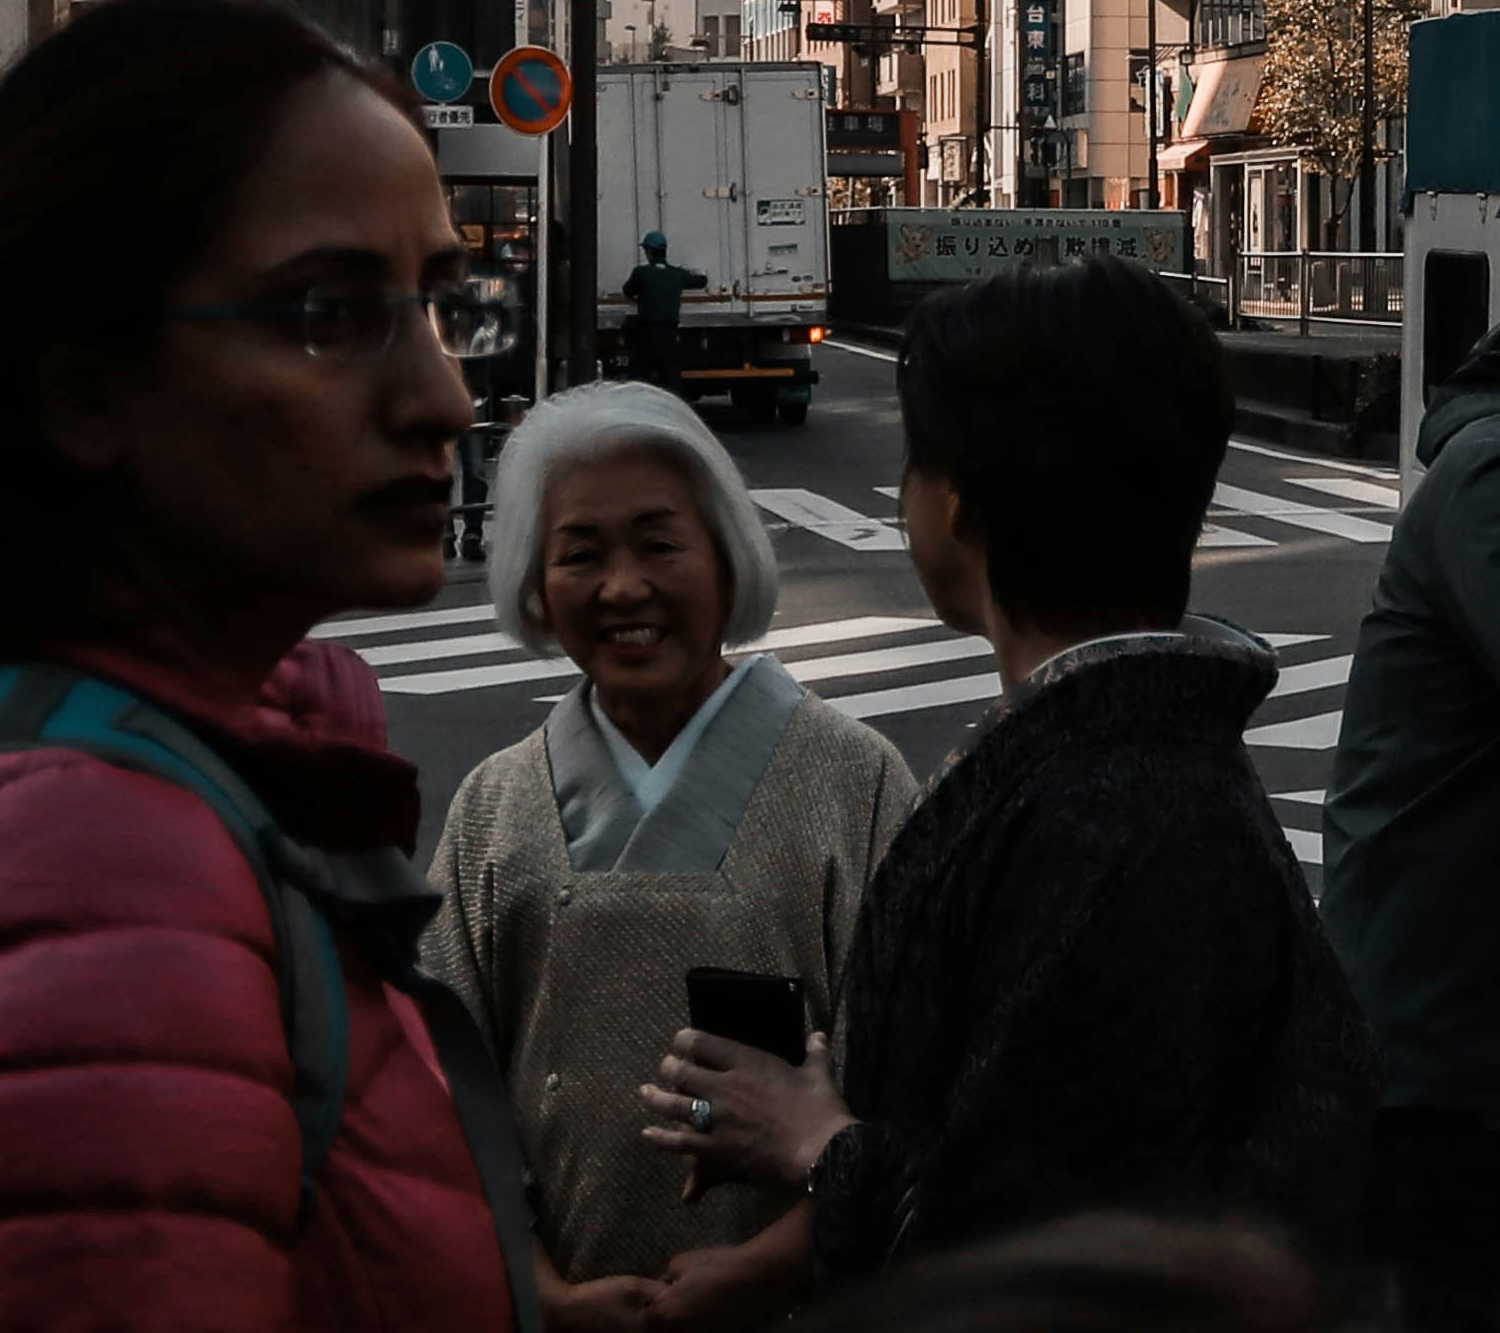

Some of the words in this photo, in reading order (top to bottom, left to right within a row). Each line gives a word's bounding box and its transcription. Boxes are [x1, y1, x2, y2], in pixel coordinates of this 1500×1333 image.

[936, 235, 1138, 258] 振り込め欺滅
